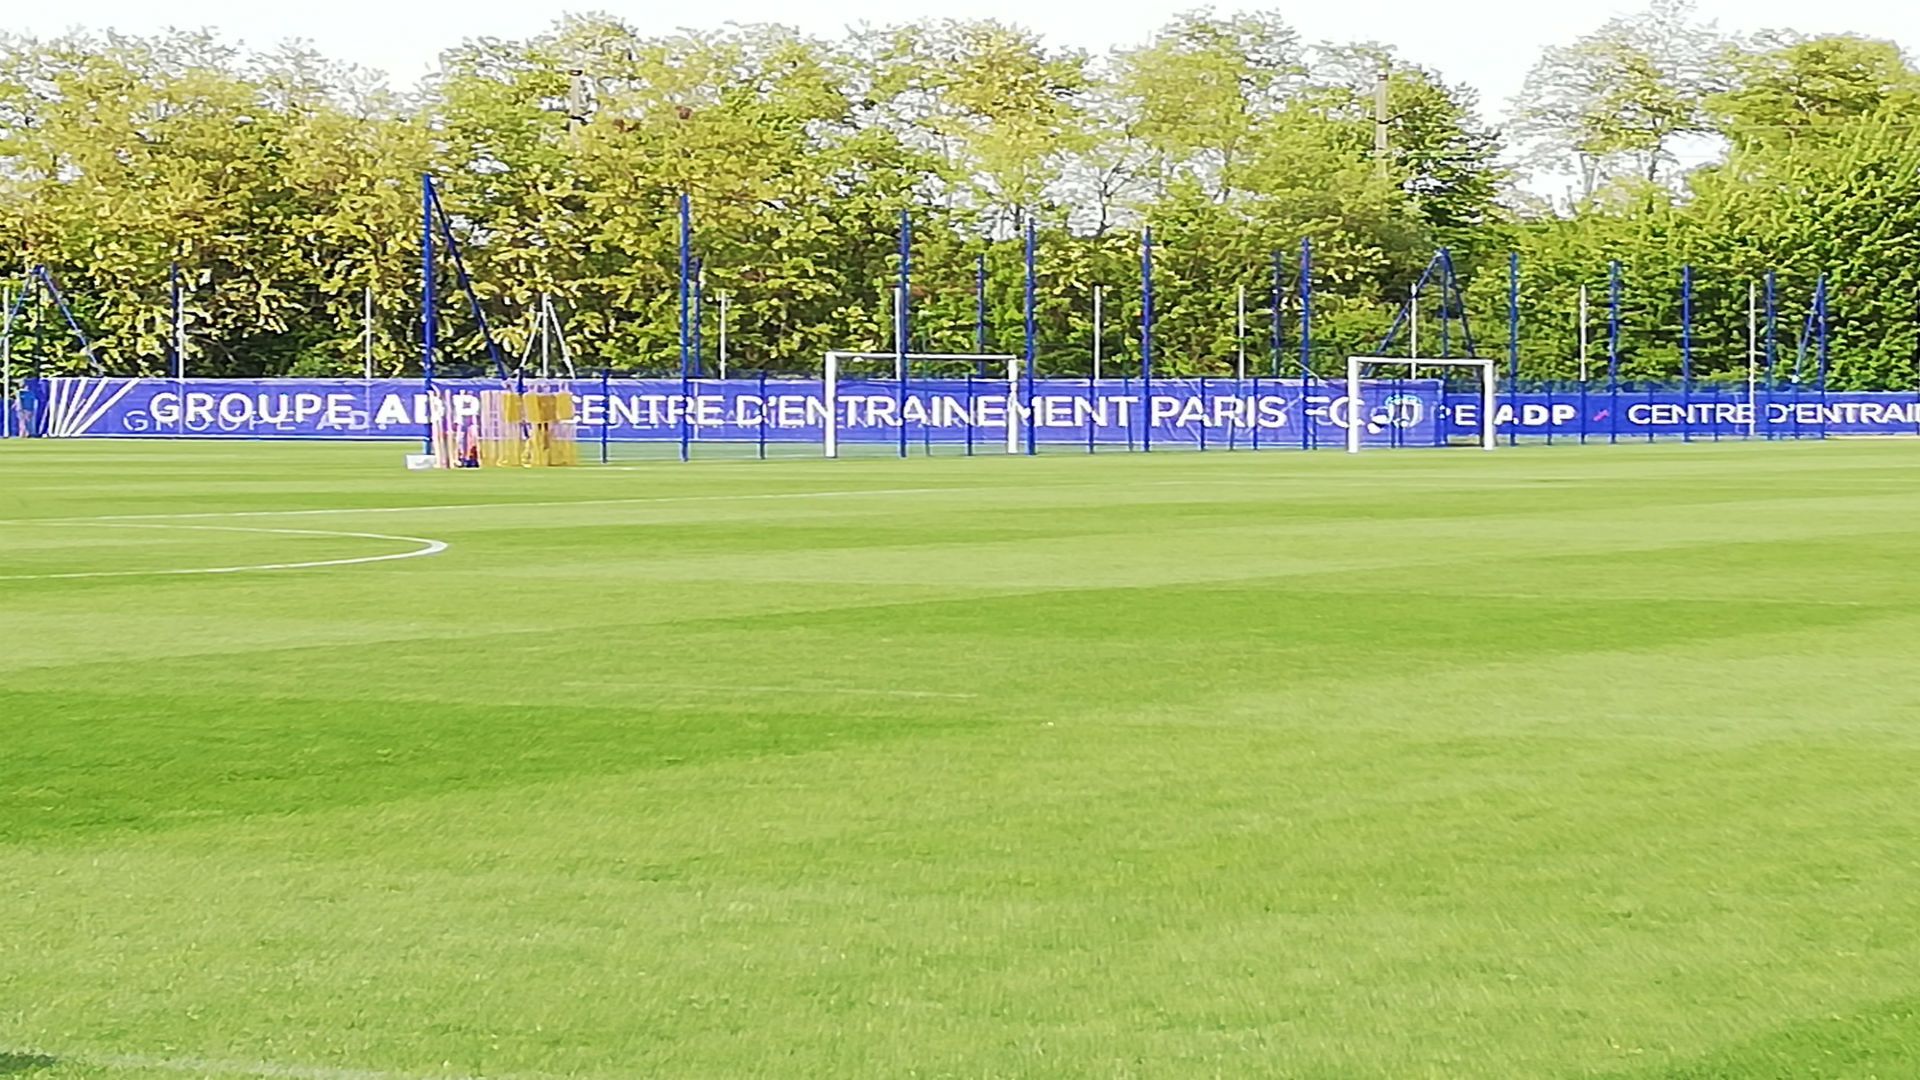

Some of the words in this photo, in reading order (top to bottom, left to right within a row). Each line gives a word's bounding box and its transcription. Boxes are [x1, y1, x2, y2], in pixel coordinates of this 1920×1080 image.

[150, 392, 354, 424] GROUPE
[1151, 396, 1287, 428] PARIS
[1494, 404, 1576, 426] ADP
[1628, 404, 1755, 425] CENTRE
[1767, 403, 1920, 425] D'ENTRAI
